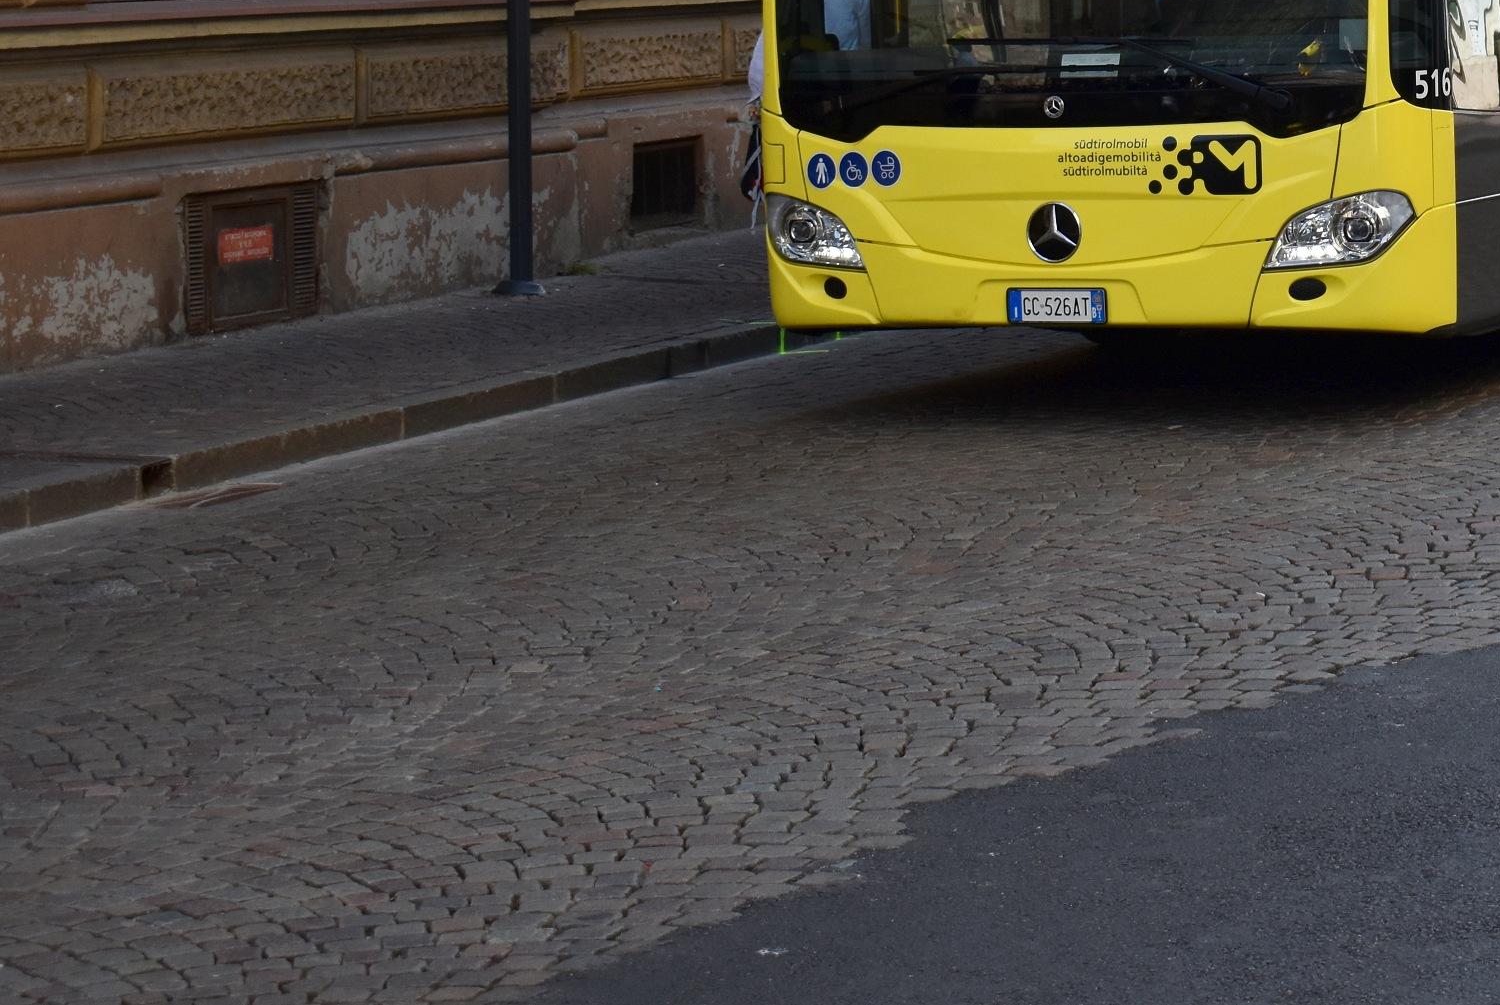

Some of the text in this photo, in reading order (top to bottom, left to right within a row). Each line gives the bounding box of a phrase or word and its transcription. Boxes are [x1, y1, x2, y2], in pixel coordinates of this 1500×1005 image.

[1415, 67, 1451, 99] 516
[1074, 138, 1148, 150] südtirolmobil
[1057, 152, 1161, 164] altoadigemobilità
[1063, 164, 1148, 177] südtirolmubiltà
